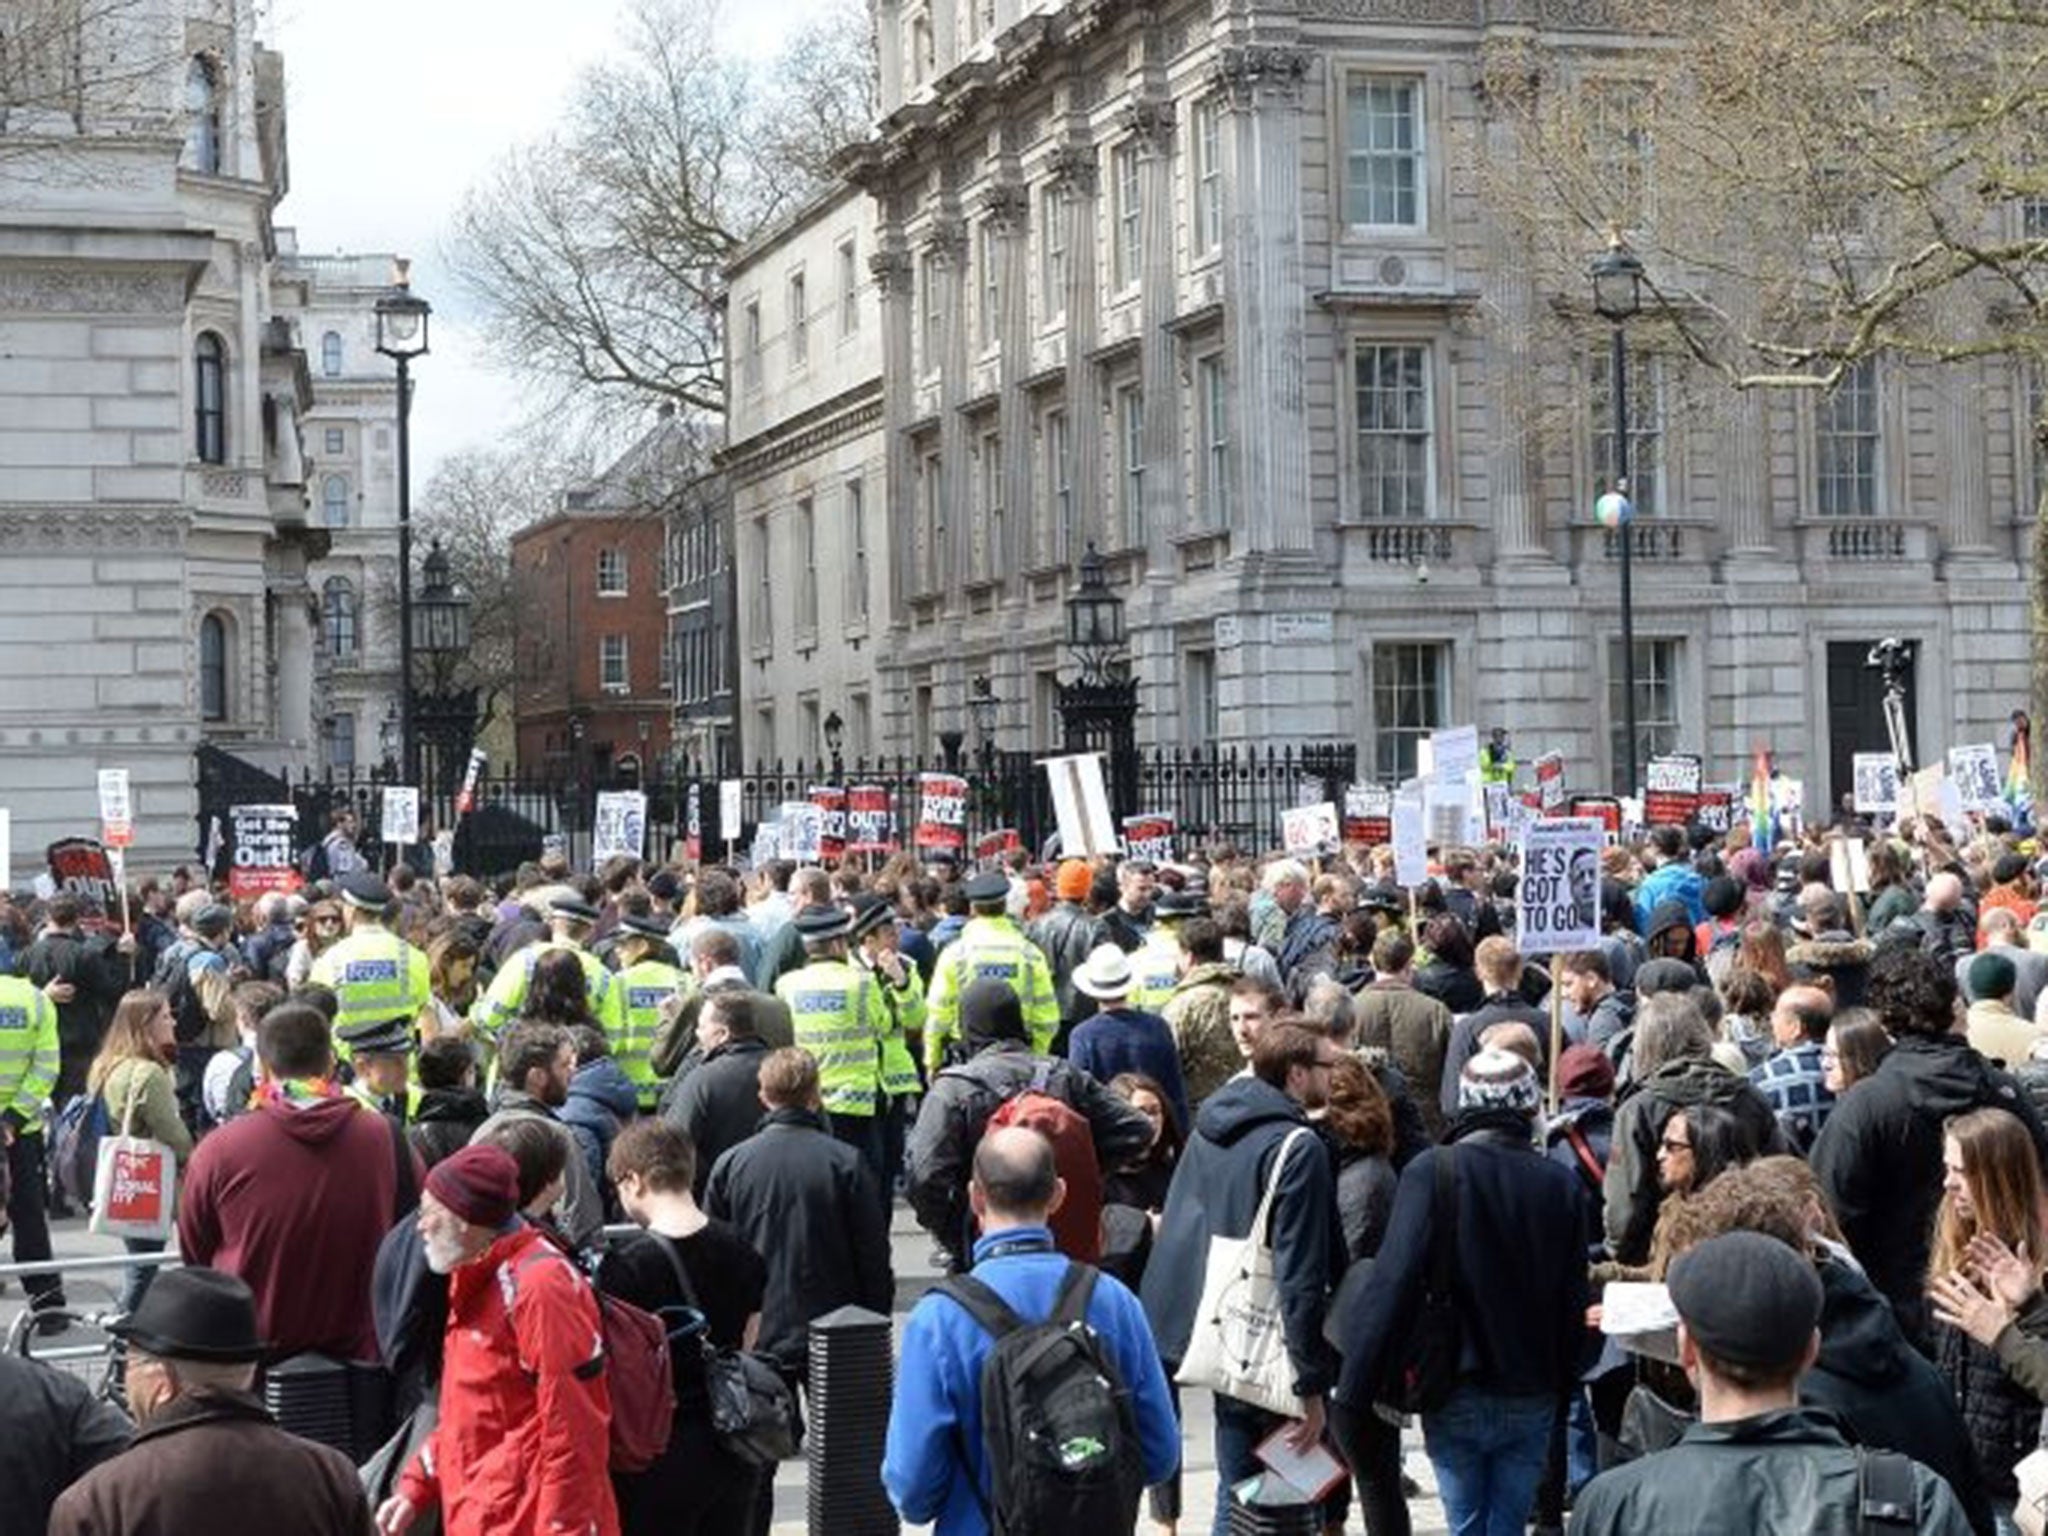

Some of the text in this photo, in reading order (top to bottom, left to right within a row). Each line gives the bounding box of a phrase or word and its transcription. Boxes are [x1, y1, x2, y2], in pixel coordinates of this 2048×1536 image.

[923, 796, 966, 811] TORY
[922, 809, 964, 824] RULE
[235, 830, 290, 846] Tories
[235, 847, 289, 867] Out!
[1525, 847, 1566, 875] HE'S
[1523, 876, 1561, 904] GOT
[1523, 904, 1577, 932] TO GO
